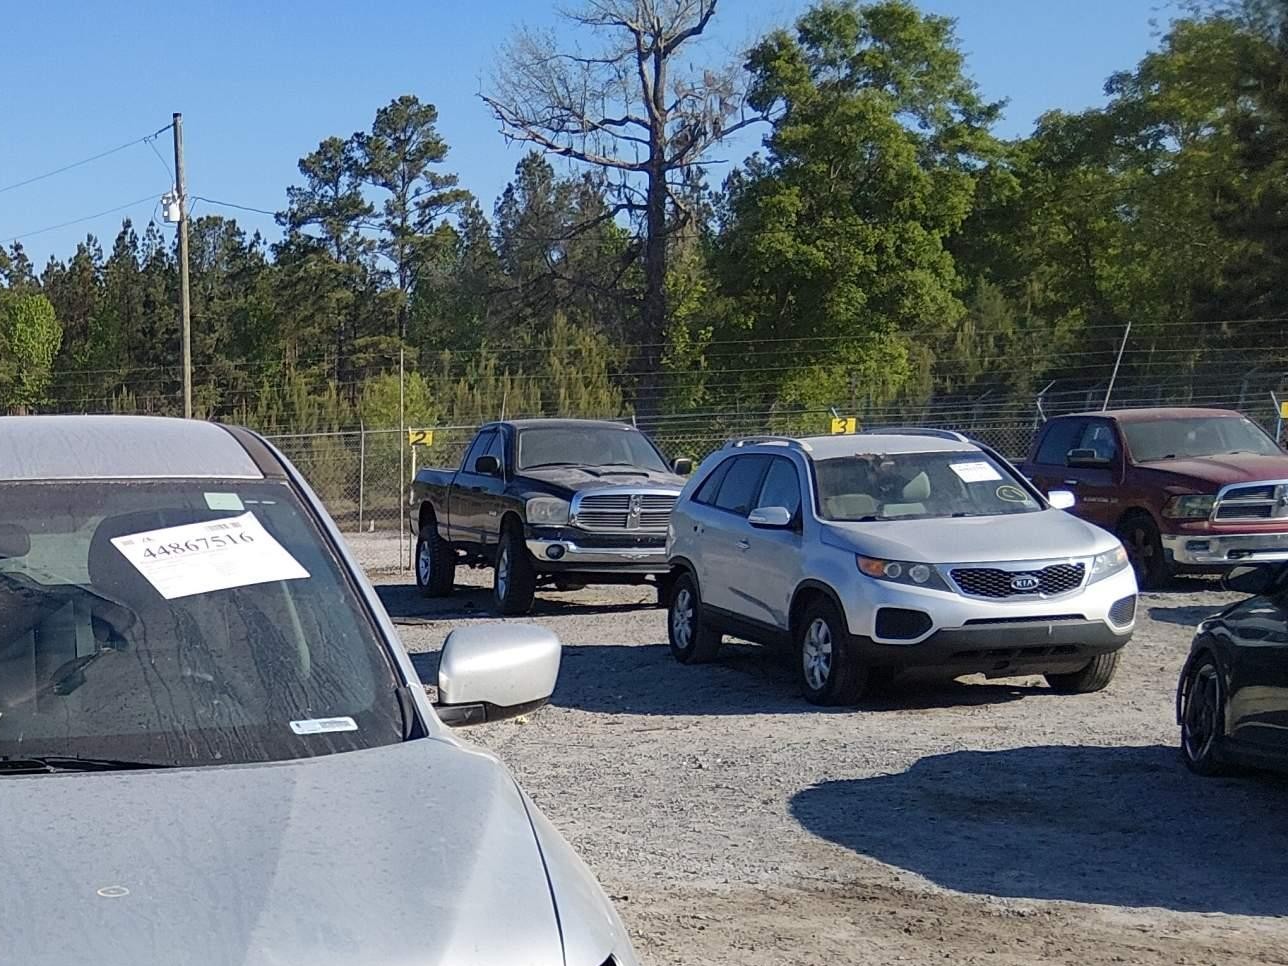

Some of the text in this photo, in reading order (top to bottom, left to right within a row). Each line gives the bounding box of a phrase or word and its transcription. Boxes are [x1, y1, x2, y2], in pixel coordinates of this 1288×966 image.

[836, 418, 849, 434] 3
[411, 431, 427, 446] 2
[143, 531, 254, 559] 44867516
